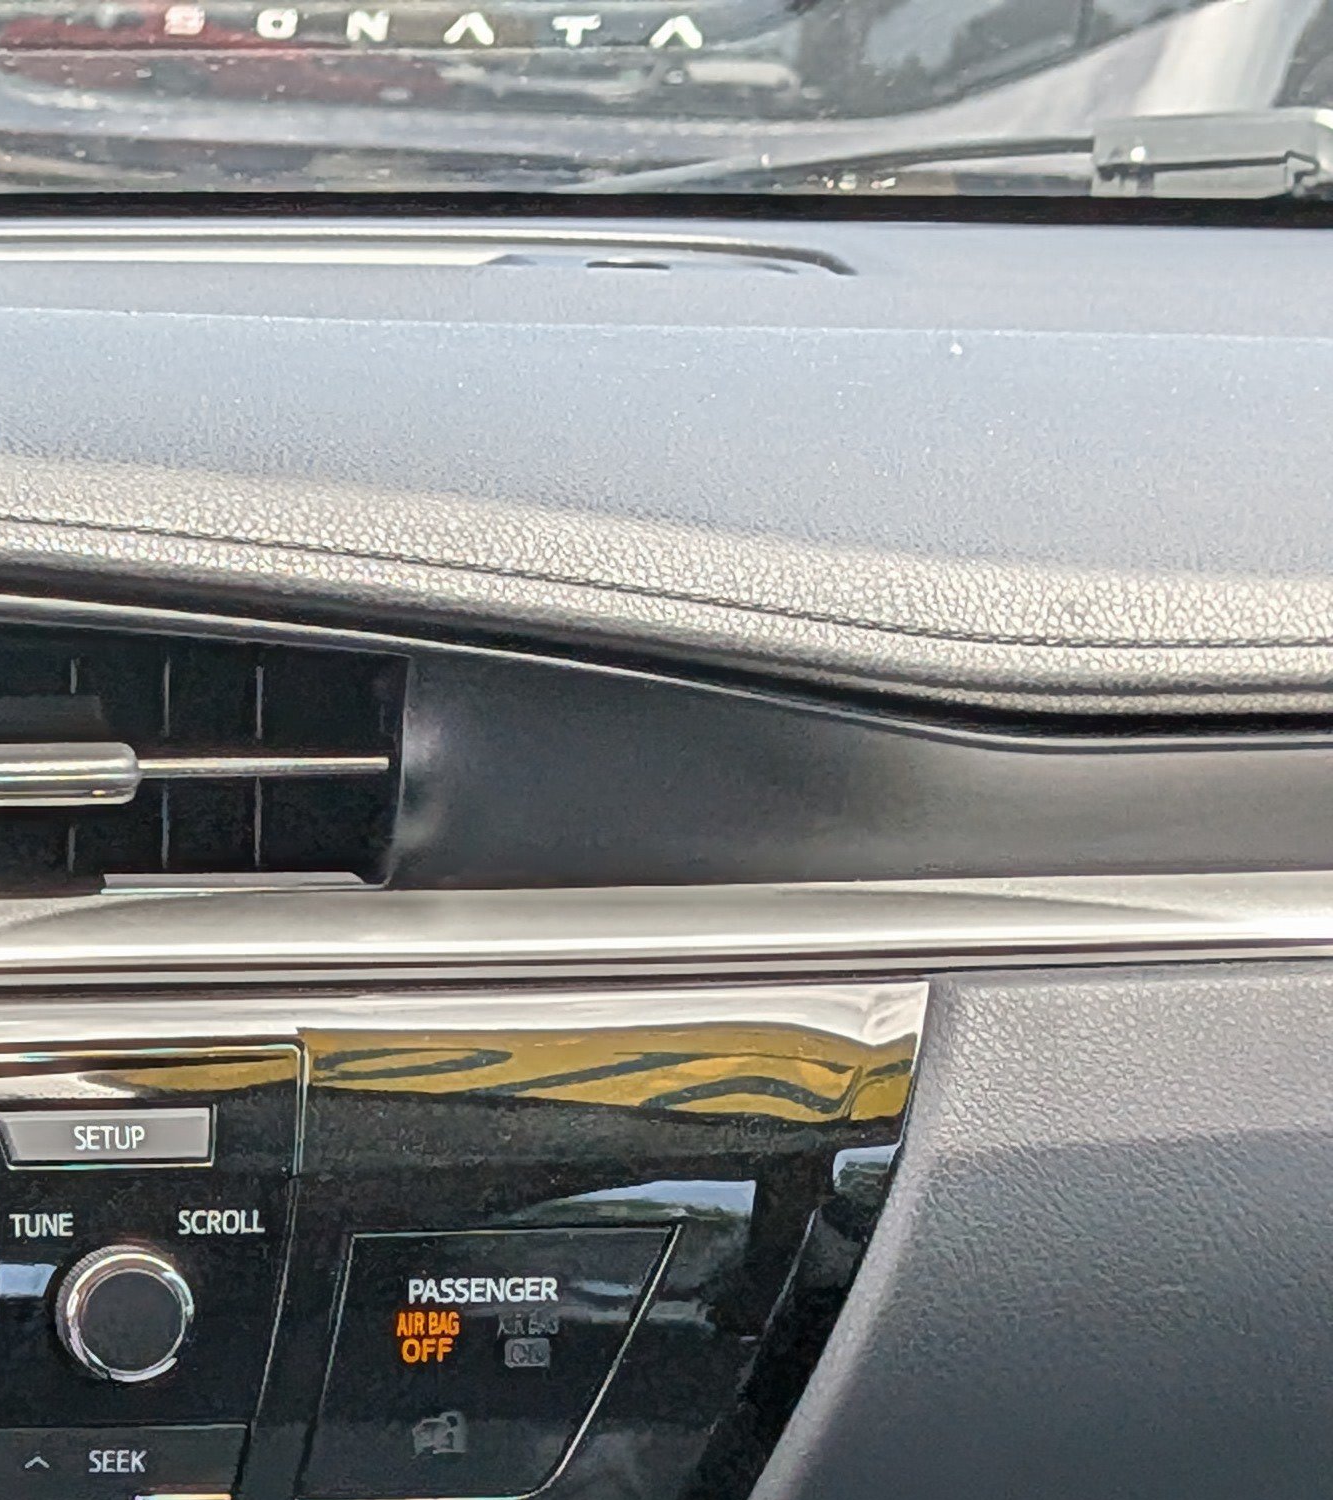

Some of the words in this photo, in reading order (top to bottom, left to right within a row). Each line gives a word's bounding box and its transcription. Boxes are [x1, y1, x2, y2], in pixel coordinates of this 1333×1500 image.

[163, 6, 703, 48] SONATA
[73, 1125, 146, 1151] SETUP
[9, 1213, 74, 1239] TUNE
[178, 1209, 266, 1235] SCROLL
[407, 1276, 560, 1304] PASSENGER
[396, 1311, 425, 1337] AIR
[428, 1310, 461, 1336] BAG
[400, 1337, 454, 1364] OFF
[88, 1449, 148, 1474] SEEK
